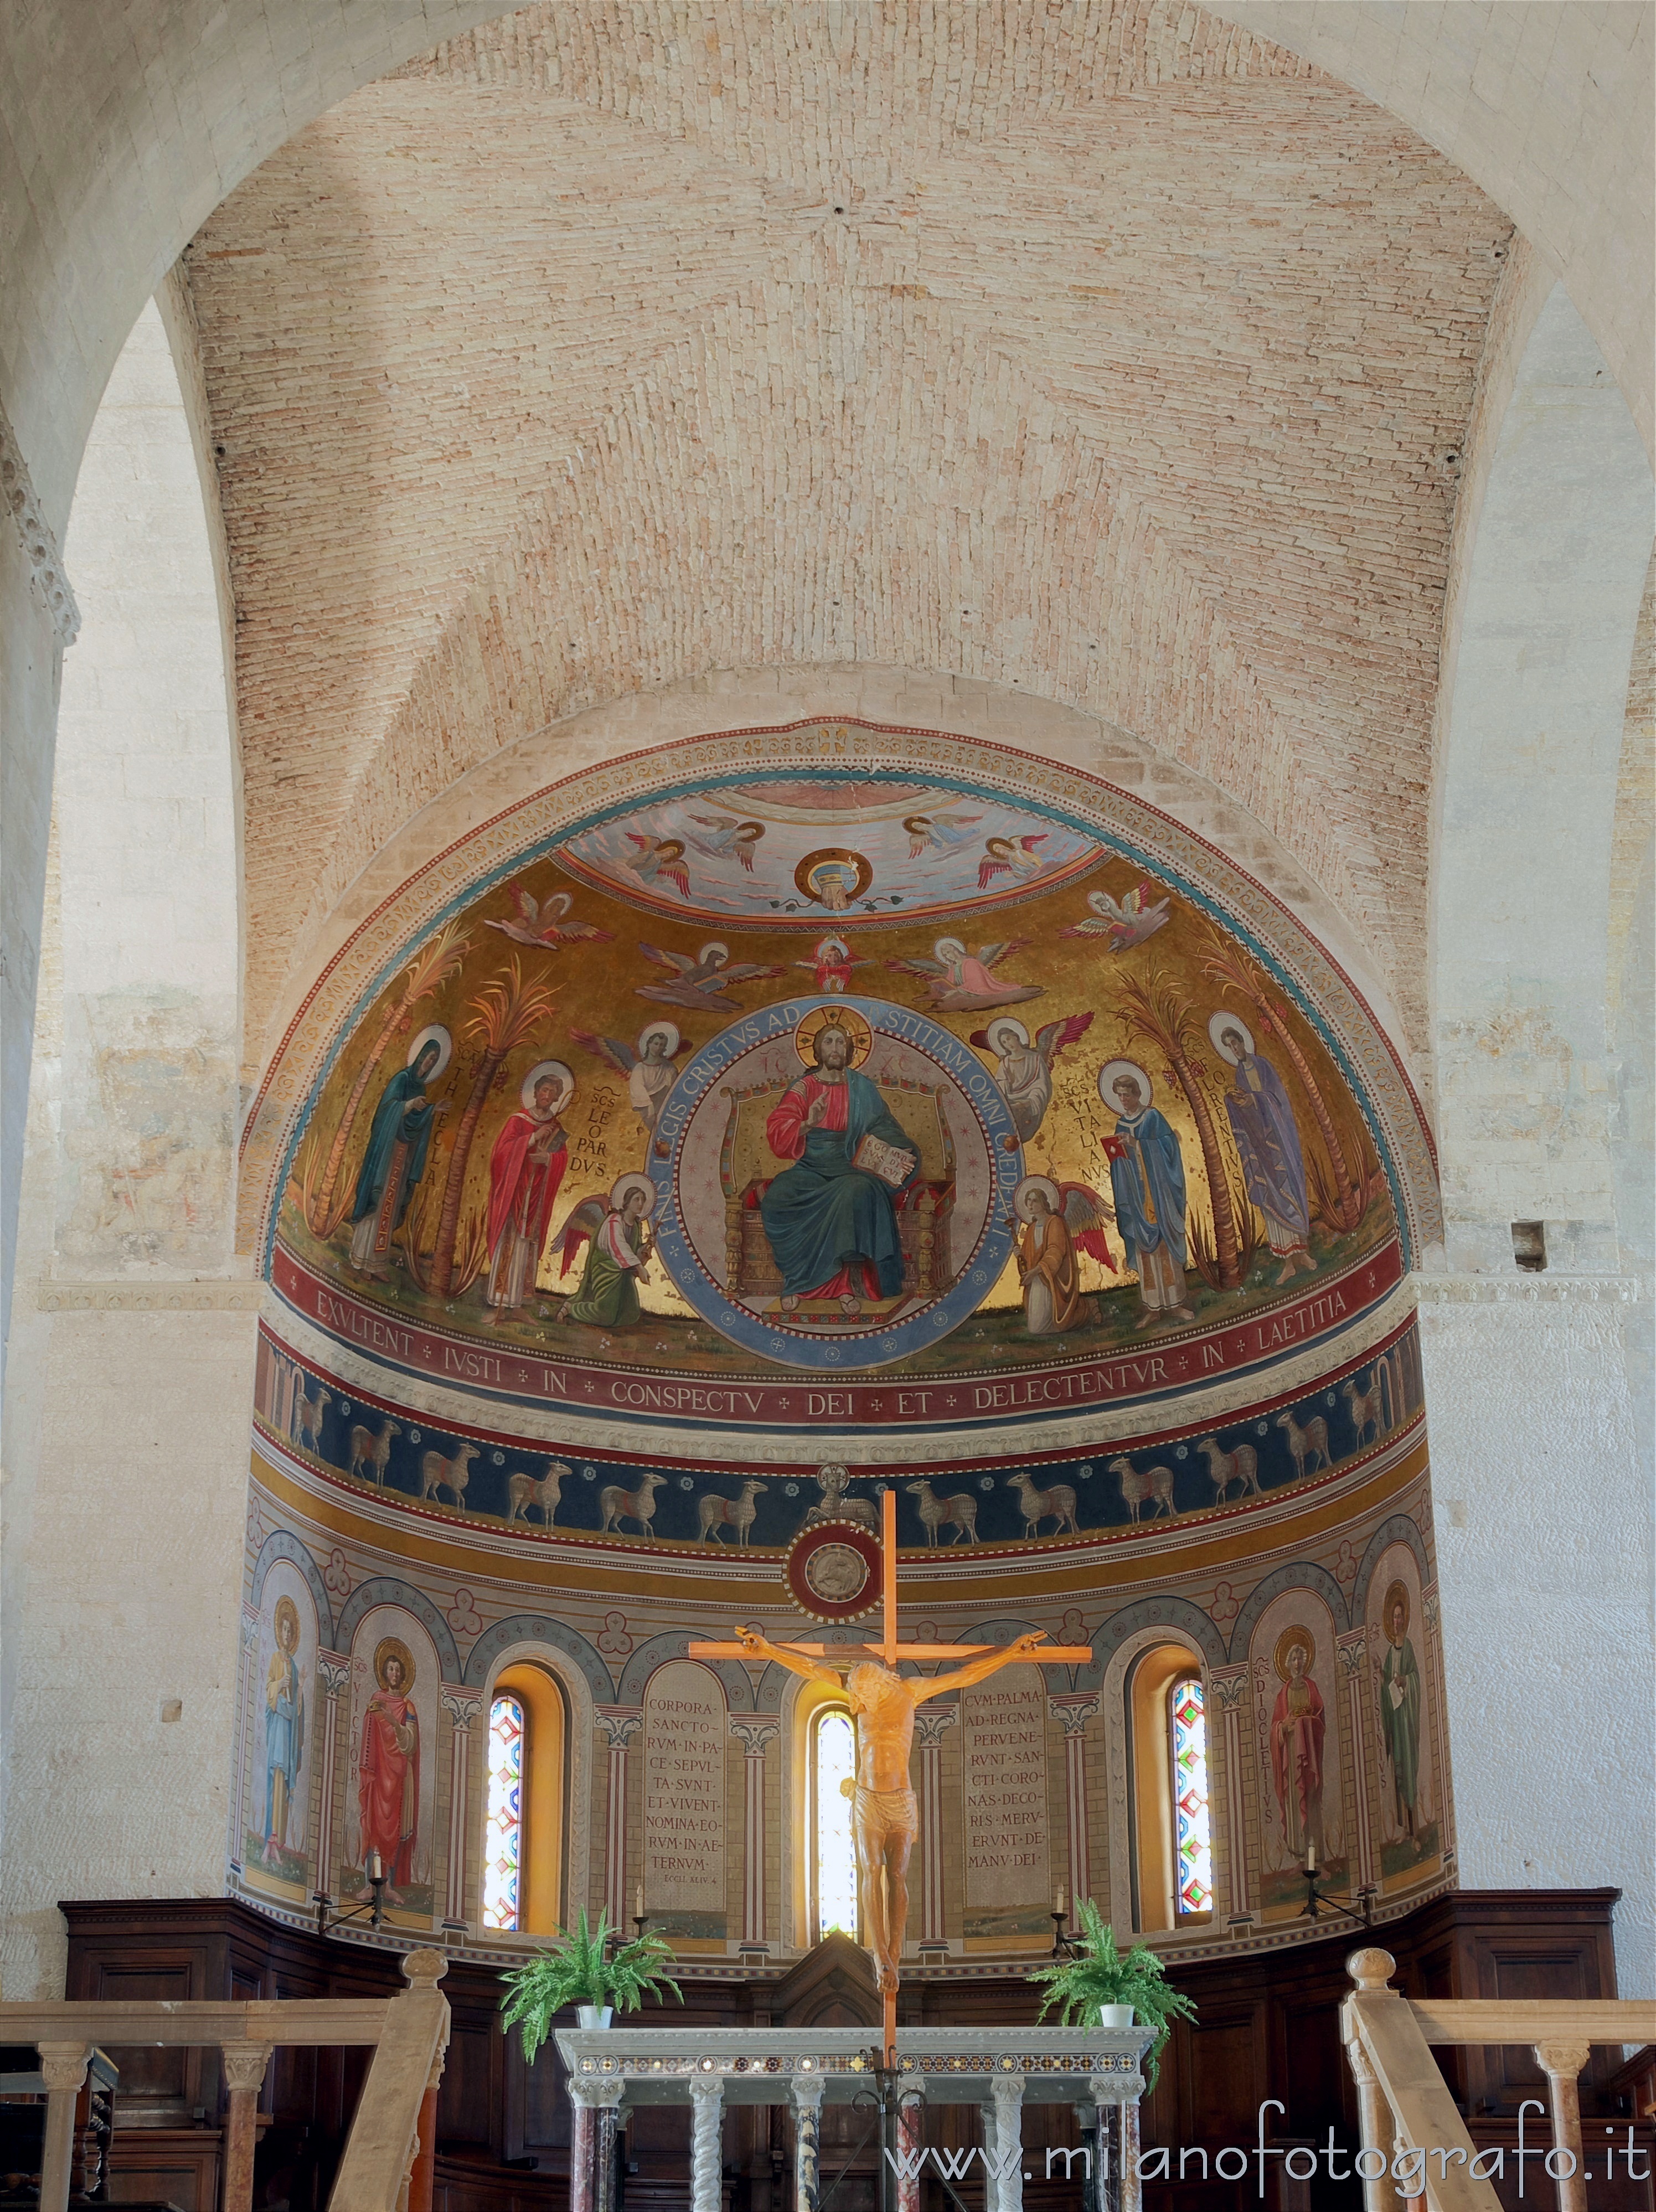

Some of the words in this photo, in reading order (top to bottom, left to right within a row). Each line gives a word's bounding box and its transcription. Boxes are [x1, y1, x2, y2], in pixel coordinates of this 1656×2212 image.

[682, 1022, 760, 1095] CRISTVS
[768, 1006, 801, 1032] AD
[969, 1074, 1007, 1126] OMNI
[1063, 1083, 1089, 1099] SCS
[591, 1093, 616, 1107] SCS
[588, 1108, 611, 1125] LE
[1074, 1115, 1101, 1131] TA
[589, 1125, 601, 1138] O
[1080, 1131, 1098, 1148] LI
[577, 1137, 607, 1158] PAR
[1089, 1149, 1101, 1164] A
[570, 1157, 606, 1177] DVS
[1081, 1164, 1111, 1183] NVS
[318, 1290, 414, 1357] EXVLTENT
[445, 1347, 501, 1382] IVSTI
[544, 1370, 566, 1394] IN
[611, 1381, 765, 1414] CONSPECTV
[808, 1393, 854, 1416] DEI
[898, 1391, 933, 1415] ET
[974, 1357, 1169, 1410] DELECTENTVR
[1203, 1340, 1225, 1369] IN
[1258, 1291, 1347, 1351] LAETITIA
[354, 1662, 368, 1673] SCS
[1253, 1664, 1270, 1679] SCS
[964, 1694, 993, 1707] CVM
[997, 1690, 1040, 1705] PALMA
[649, 1699, 712, 1715] CORPORA
[965, 1716, 984, 1727] AD
[990, 1714, 1035, 1726] REGNA
[350, 1682, 361, 1781] VICTOR
[647, 1737, 678, 1750] RVM
[684, 1740, 698, 1752] IN
[649, 1757, 667, 1770] CE
[971, 1754, 1007, 1766] RVNT
[653, 1777, 670, 1789] TA
[676, 1778, 713, 1792] SVNT
[972, 1774, 995, 1786] CTI
[648, 1796, 666, 1808] ET
[670, 1798, 718, 1813] VIVENT
[968, 1795, 997, 1807] NAS
[646, 1816, 696, 1831] NOMINA
[970, 1814, 993, 1827] RIS
[648, 1836, 678, 1849] RVM
[684, 1837, 697, 1850] IN
[972, 1834, 1019, 1848] ERVNT
[651, 1856, 705, 1871] TERNVM
[968, 1855, 1010, 1868] MANV
[1014, 1853, 1037, 1866] DEI
